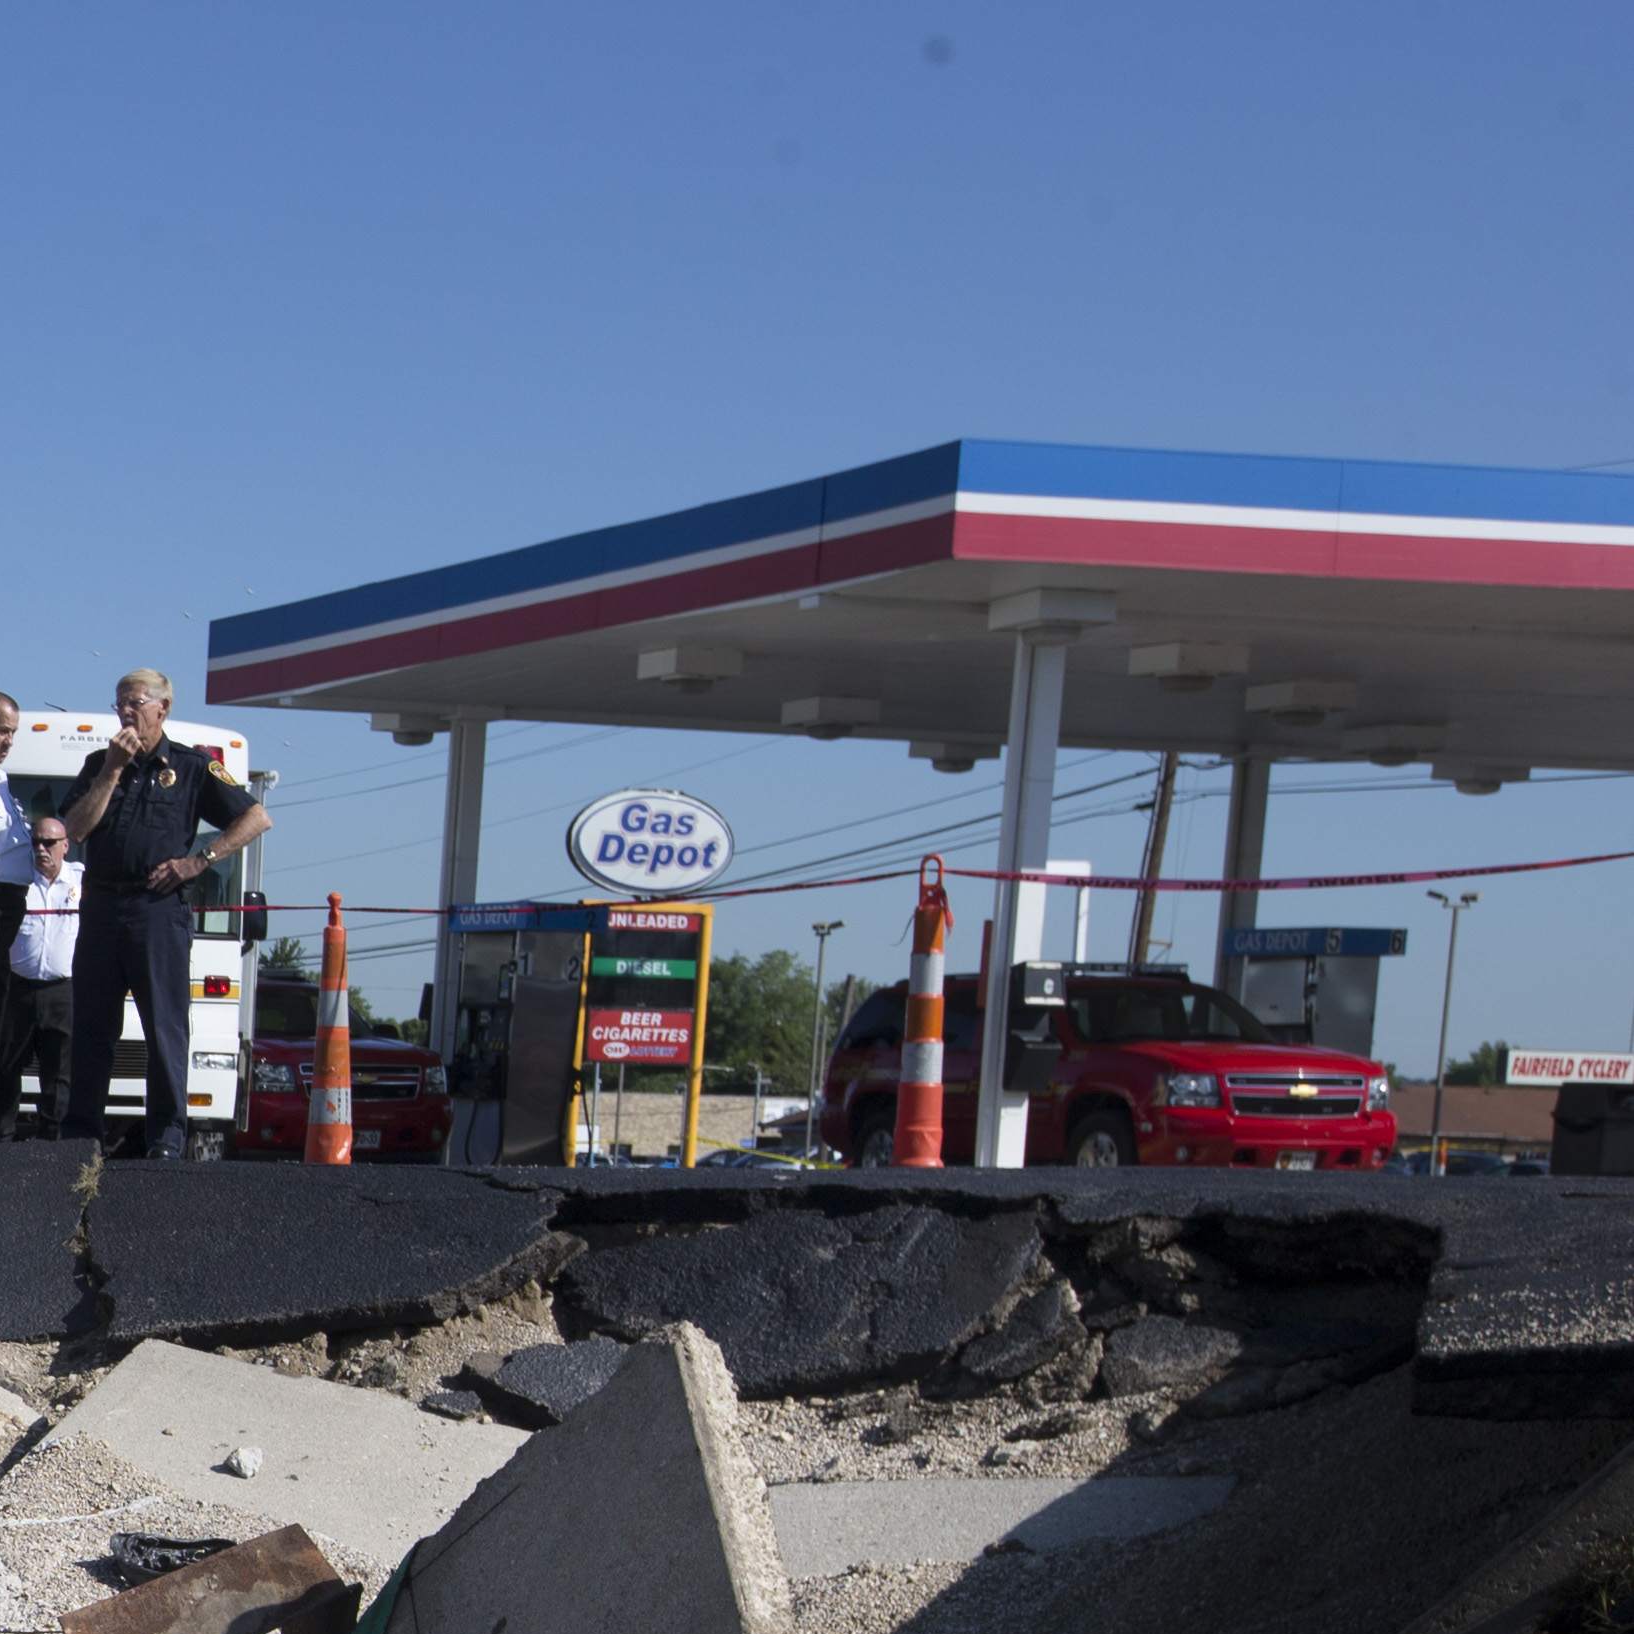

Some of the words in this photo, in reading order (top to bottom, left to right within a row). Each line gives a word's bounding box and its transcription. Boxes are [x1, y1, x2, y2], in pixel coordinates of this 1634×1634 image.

[621, 804, 695, 836] Gas
[597, 834, 717, 873] Depot
[1234, 931, 1260, 951] GAS
[1266, 931, 1309, 951] DEPOT
[1328, 928, 1340, 951] 5
[1391, 929, 1403, 953] 6
[520, 953, 528, 975] 1
[568, 956, 579, 981] 2
[616, 961, 671, 976] DIESEL
[620, 1011, 662, 1027] BEER
[592, 1026, 688, 1043] CIGARETTES
[1512, 1056, 1574, 1077] FAIRFIELD
[1577, 1058, 1630, 1079] CYCLERY
